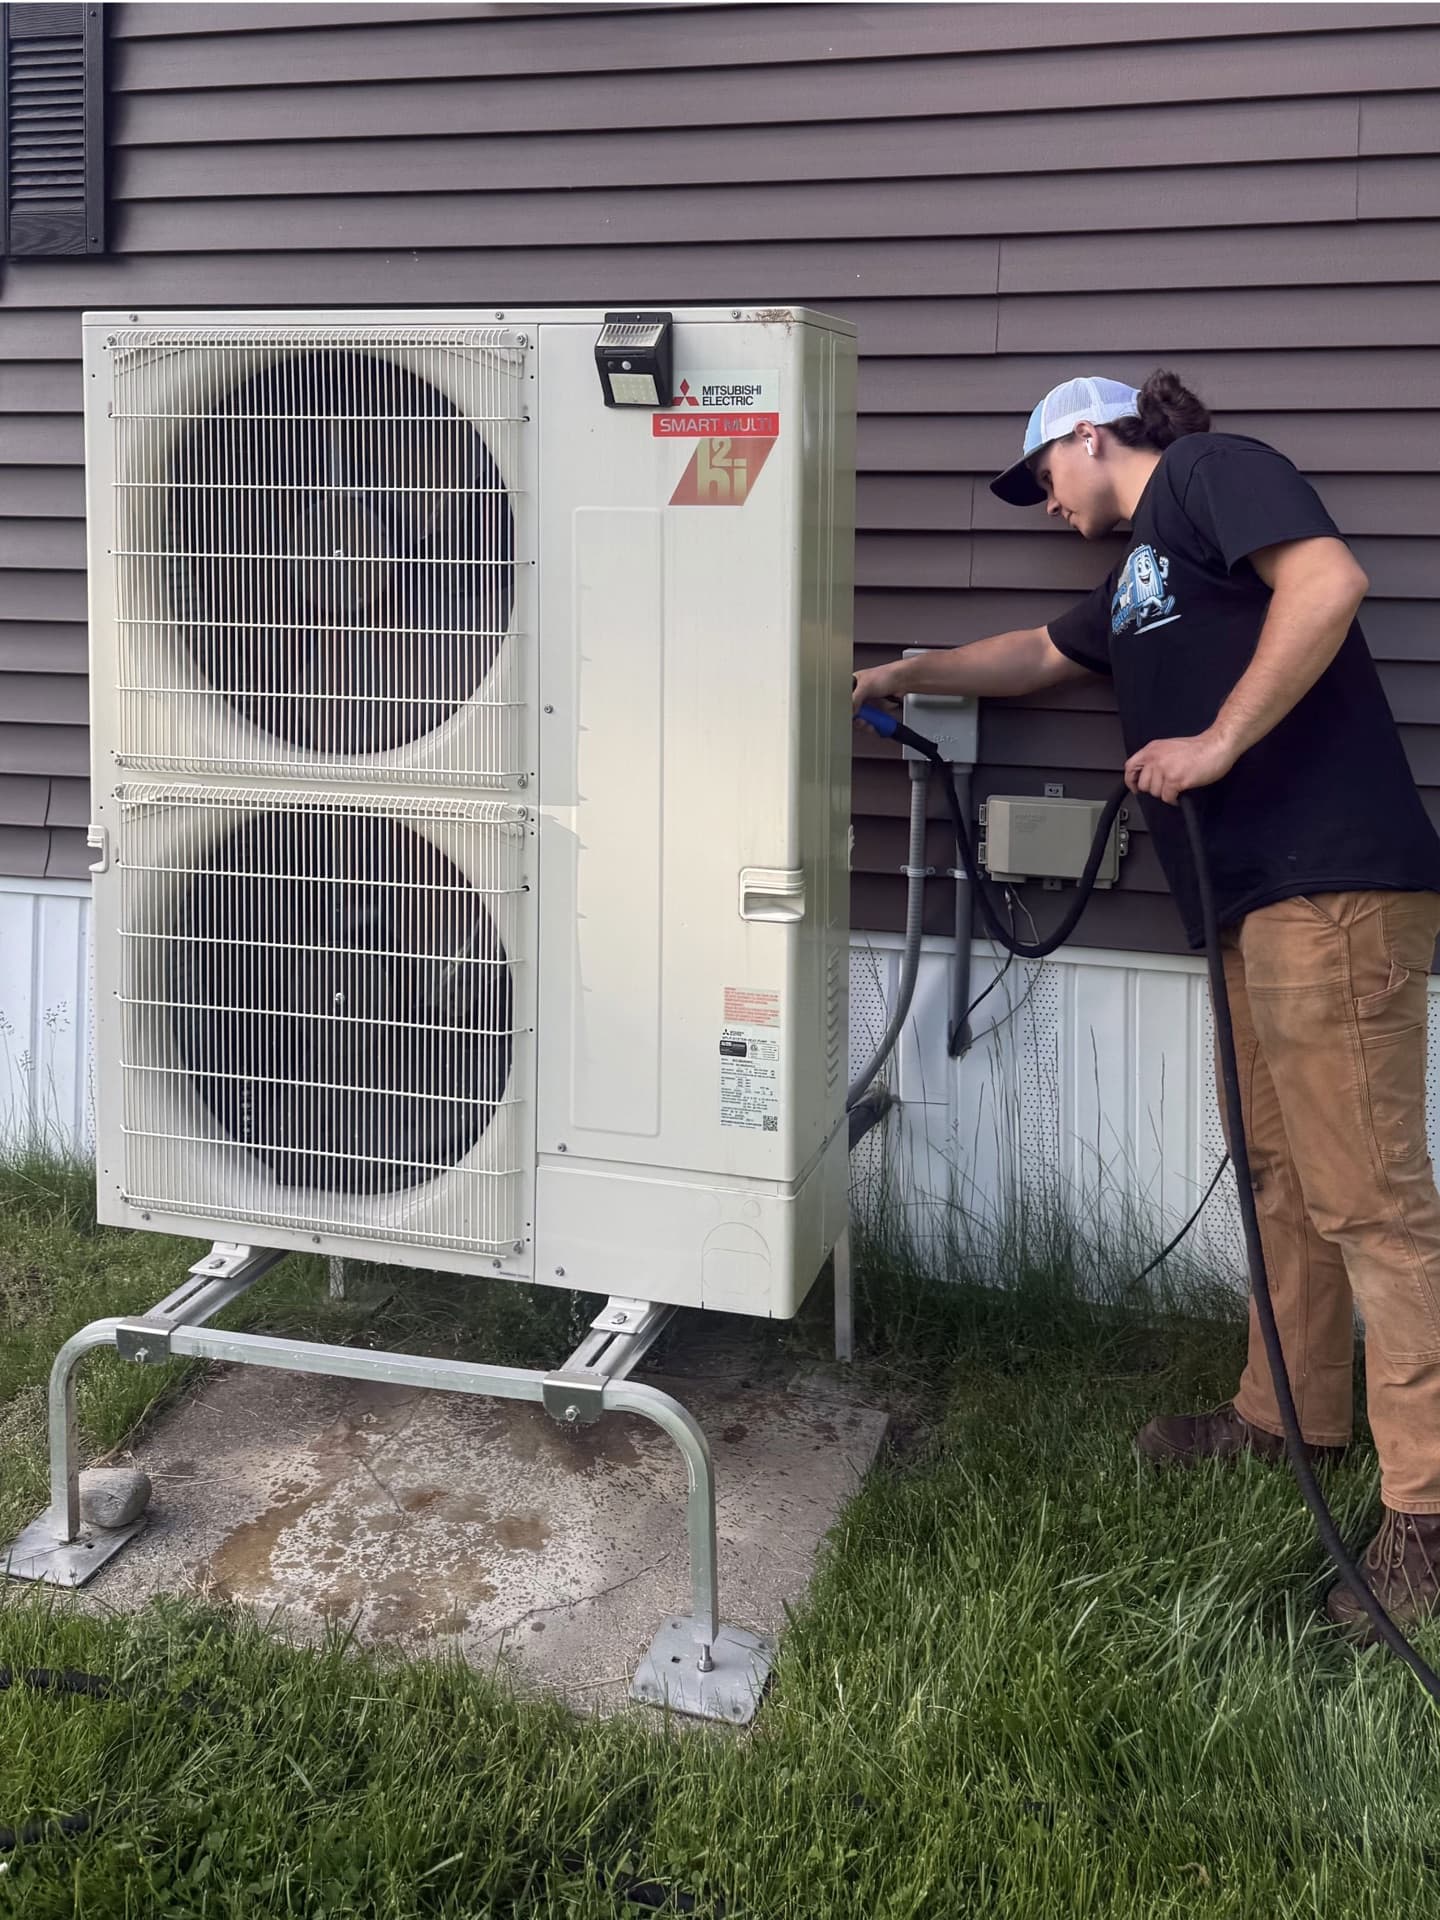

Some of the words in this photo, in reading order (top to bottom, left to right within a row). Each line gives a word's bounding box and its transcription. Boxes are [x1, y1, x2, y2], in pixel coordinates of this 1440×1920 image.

[702, 385, 762, 396] MITSUBISHI
[702, 396, 754, 406] ELECTRIC
[660, 418, 720, 432] SMART
[724, 417, 773, 432] MULTI
